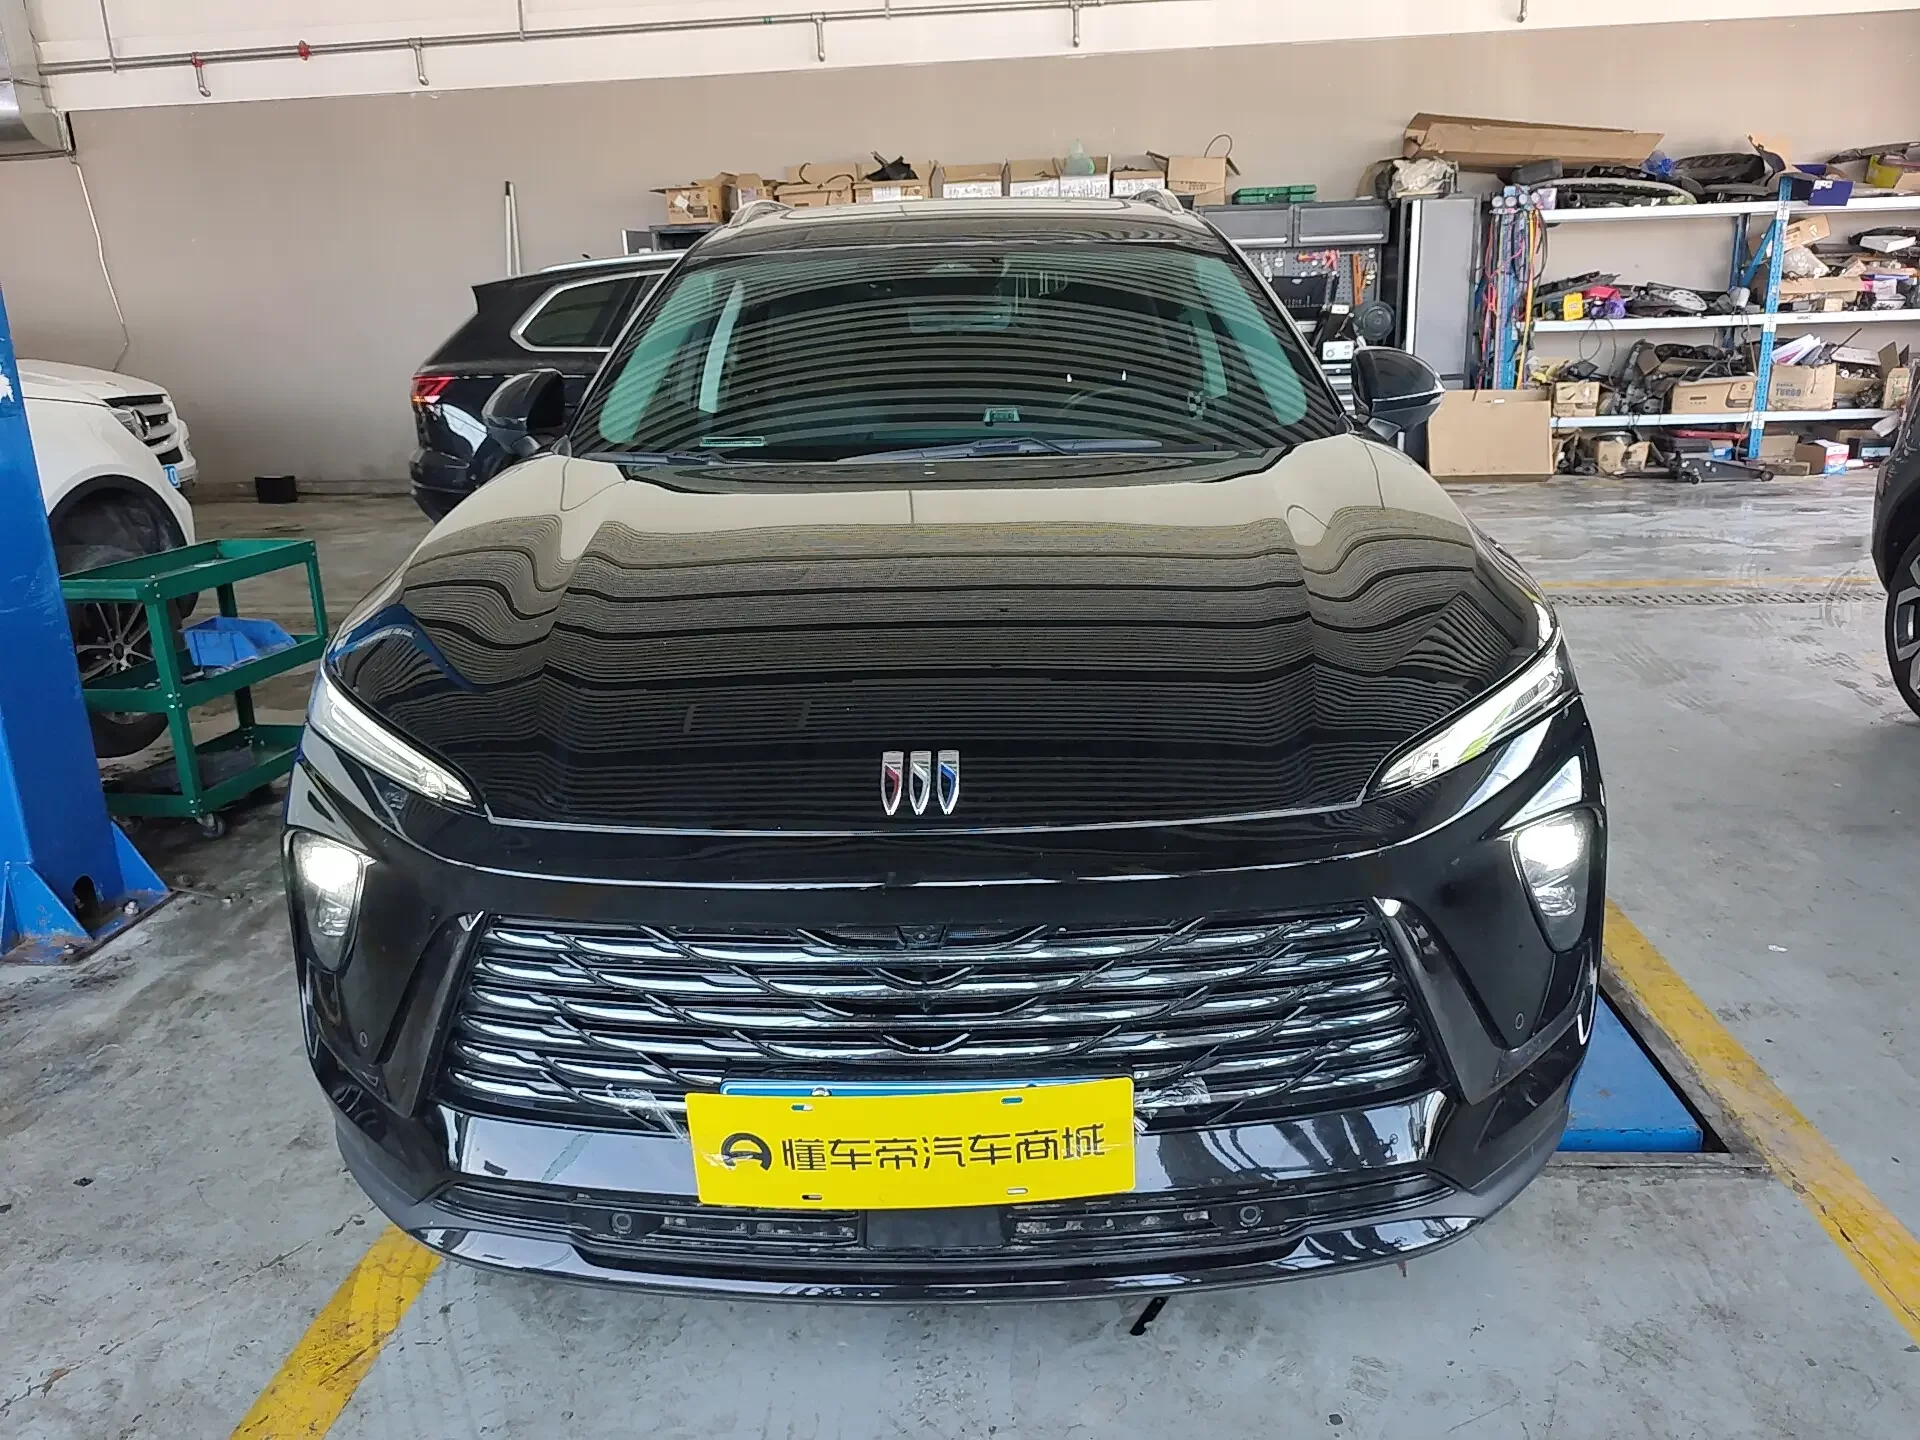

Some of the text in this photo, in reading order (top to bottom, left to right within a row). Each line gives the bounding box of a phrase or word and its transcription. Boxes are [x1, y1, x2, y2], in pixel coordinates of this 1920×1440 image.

[782, 1123, 1104, 1170] 懂车帝汽车商城
